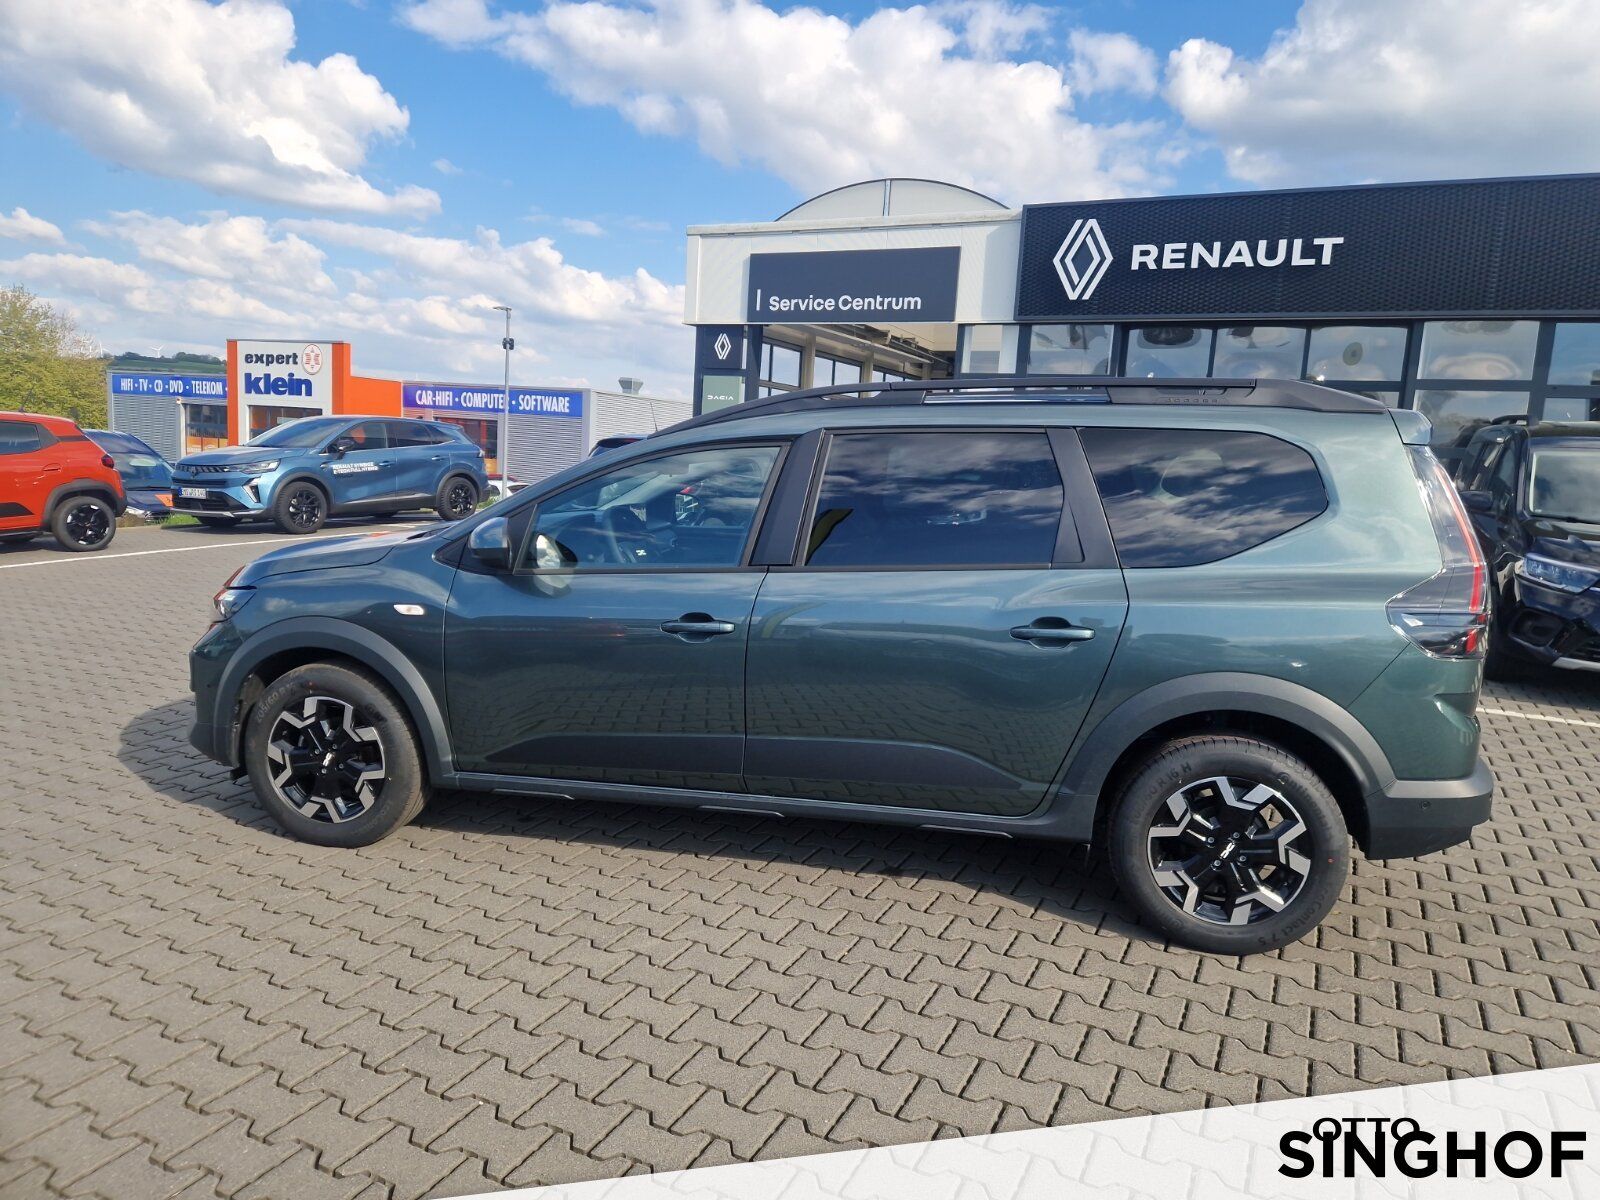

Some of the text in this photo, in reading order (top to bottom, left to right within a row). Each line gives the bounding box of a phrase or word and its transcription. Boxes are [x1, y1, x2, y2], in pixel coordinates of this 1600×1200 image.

[1131, 237, 1344, 271] RENAULT
[769, 294, 922, 312] Service Centrum
[244, 352, 299, 368] expert
[120, 378, 223, 395] HIFI TV CD DVD TELEKOM
[244, 372, 313, 397] klein
[415, 390, 453, 407] CAR-HIFI
[518, 394, 570, 413] SOFTWARE
